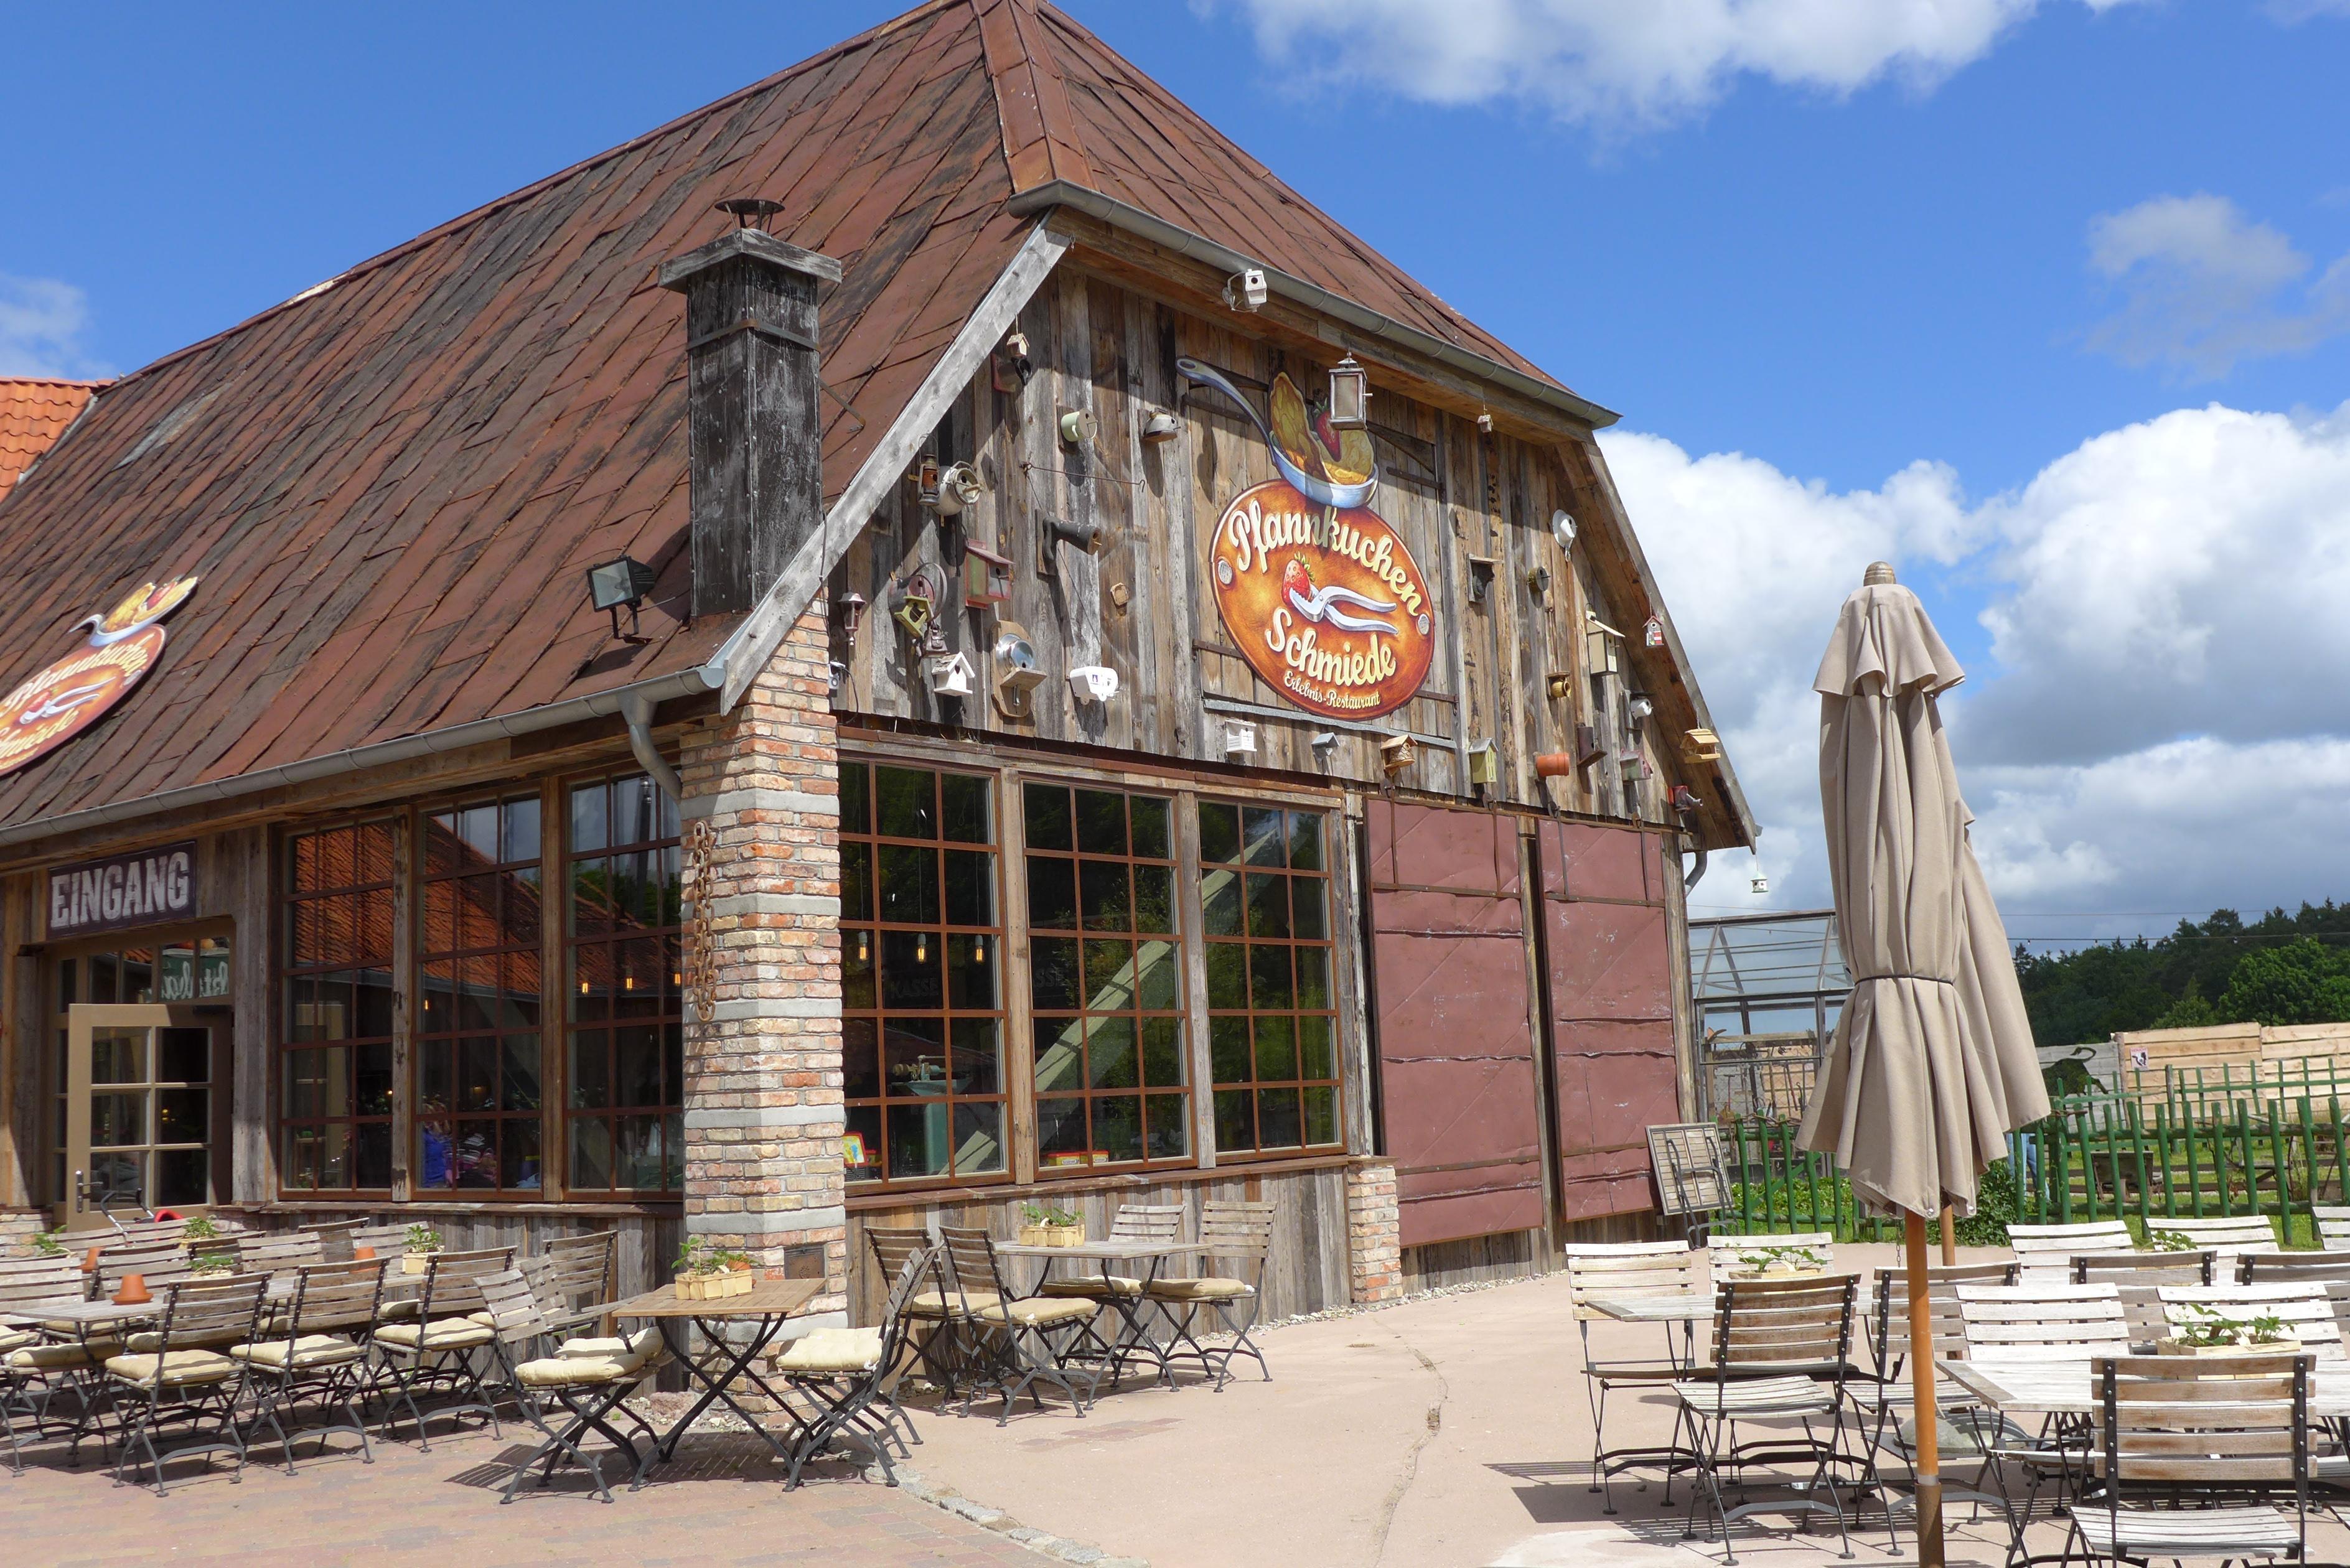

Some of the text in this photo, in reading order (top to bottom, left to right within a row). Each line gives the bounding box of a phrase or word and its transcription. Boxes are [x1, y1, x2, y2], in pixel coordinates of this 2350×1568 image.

[1228, 498, 1422, 616] Pfannkuchen
[1266, 607, 1397, 686] Schmiede
[1284, 670, 1380, 709] Erlebnis-Restaurant
[50, 852, 189, 928] EINGANG
